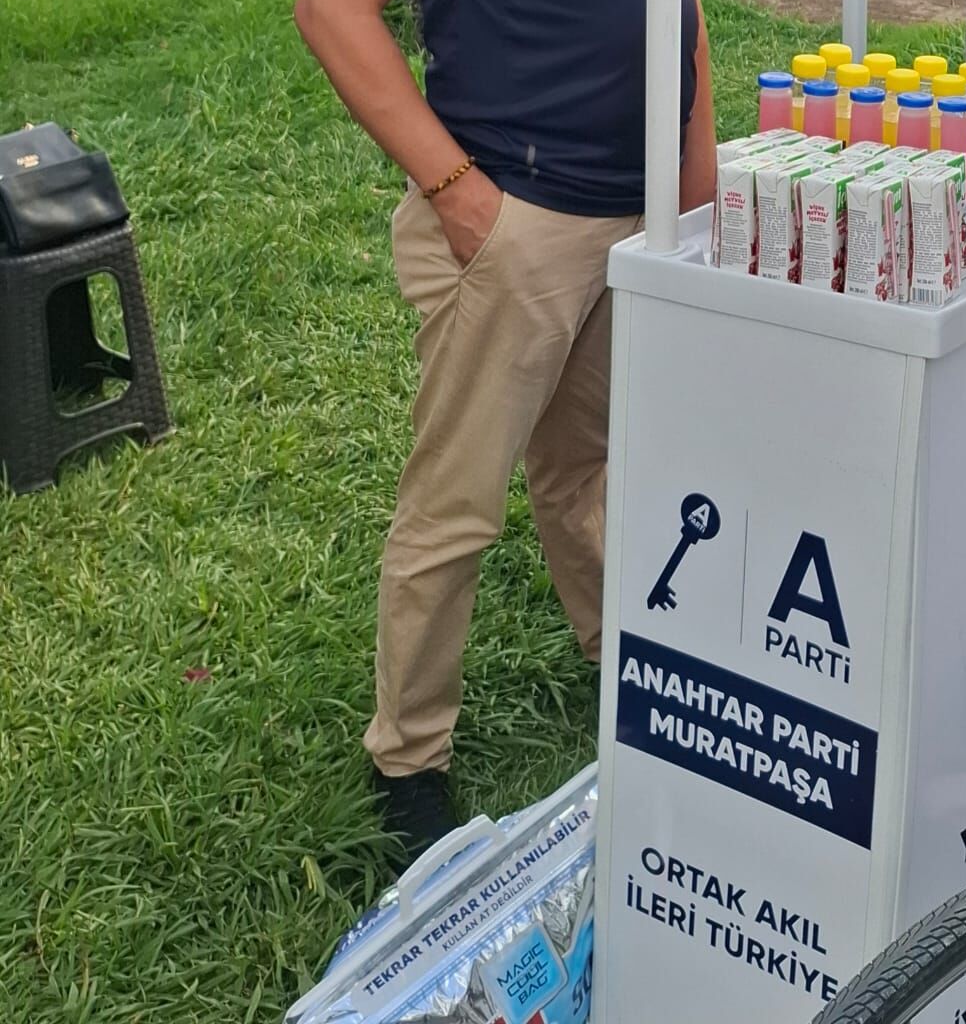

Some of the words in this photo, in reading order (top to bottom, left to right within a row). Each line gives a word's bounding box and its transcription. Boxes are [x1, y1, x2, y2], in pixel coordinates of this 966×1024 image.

[767, 530, 851, 650] A
[620, 656, 765, 737] ANAHTAR
[771, 712, 861, 777] PARTİ
[649, 706, 834, 812] MURATPAŞA
[362, 945, 424, 997] TEKRAR
[421, 898, 481, 948] TEKRAR
[479, 809, 592, 902] KULLANILABİLİR
[441, 918, 479, 952] KULLAN
[479, 908, 491, 921] AT
[492, 875, 534, 913] DEĞİLDİR
[626, 873, 696, 937] İLERİ
[705, 915, 839, 1003] TÜRKİYE
[640, 846, 746, 917] ORTAK
[754, 900, 828, 956] AKIL
[496, 941, 544, 988] MAGIC
[517, 970, 549, 1005] BAG
